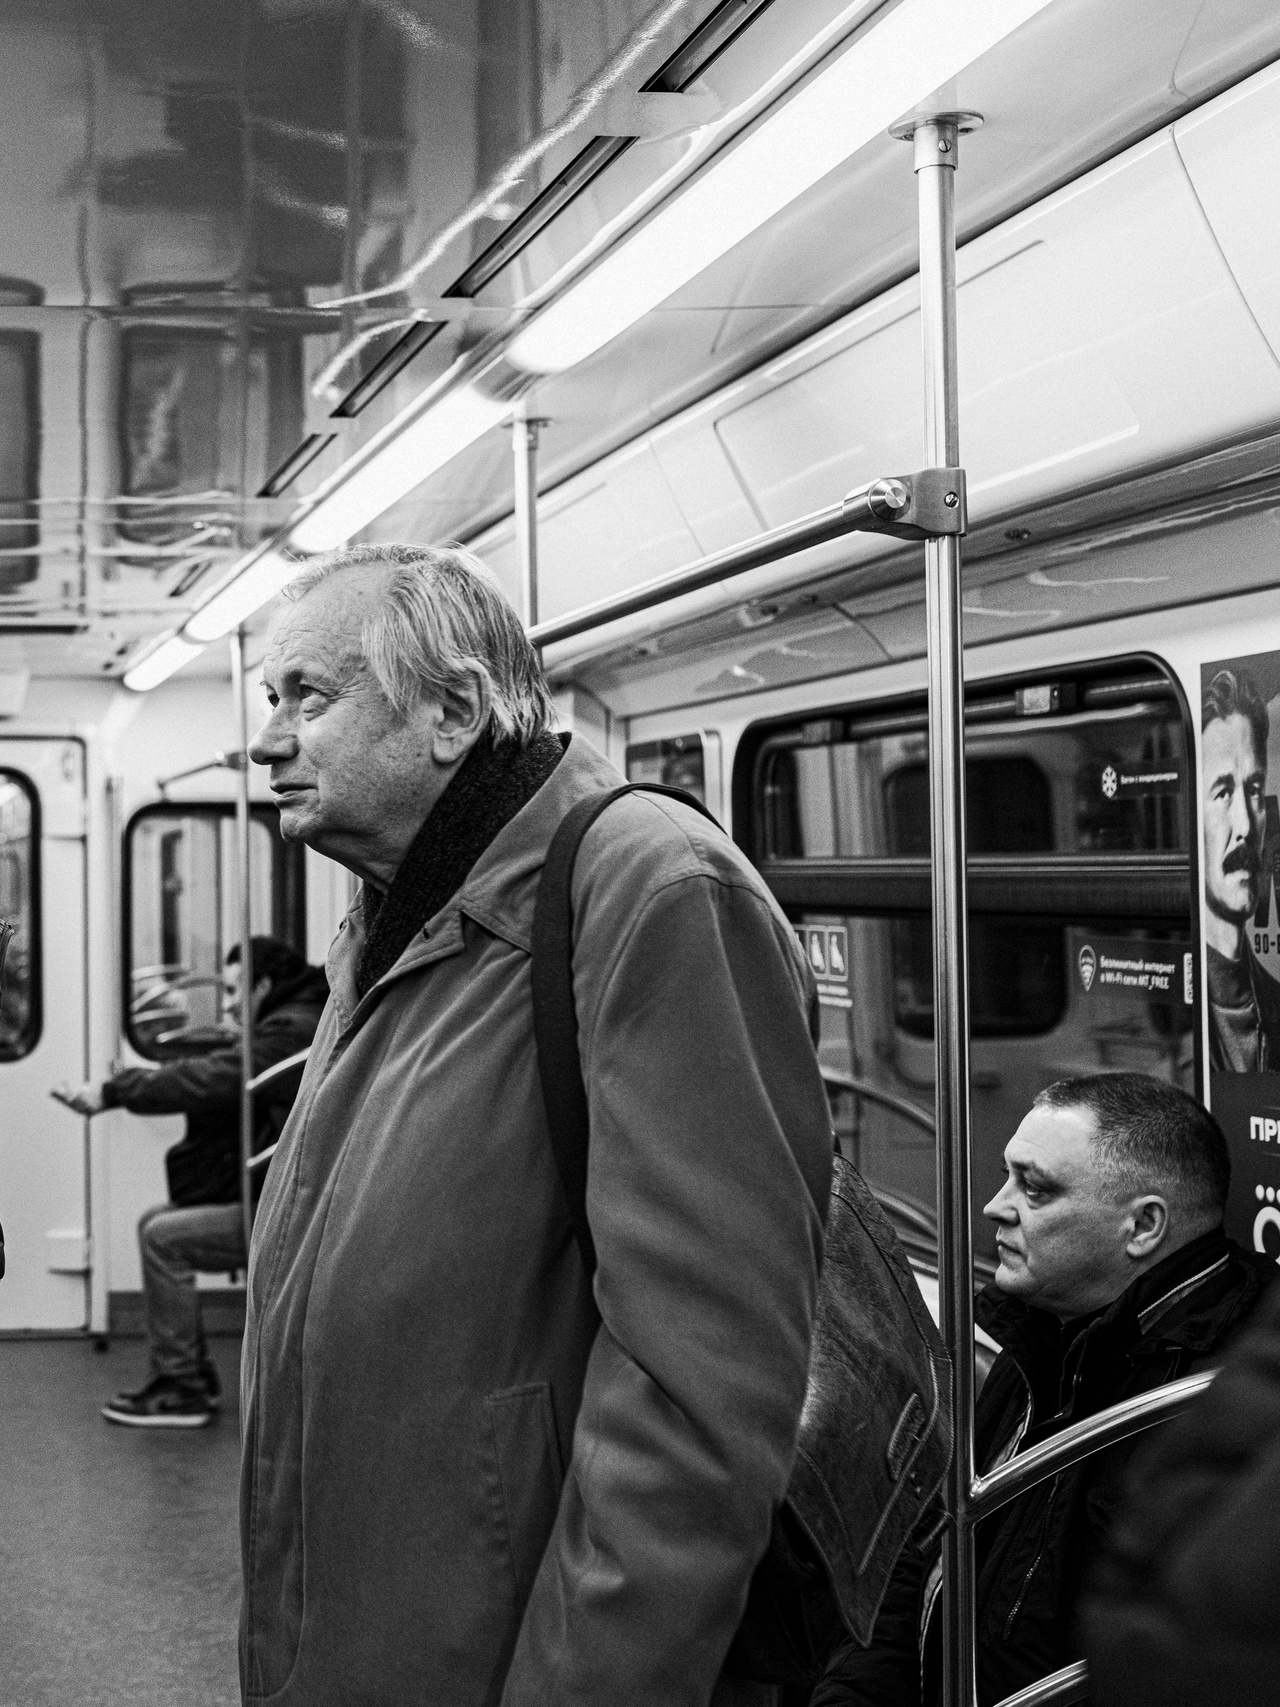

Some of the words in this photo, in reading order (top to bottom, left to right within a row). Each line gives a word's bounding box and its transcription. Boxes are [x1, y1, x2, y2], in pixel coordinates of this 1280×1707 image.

[1100, 955, 1144, 971] Безлимитный
[1144, 962, 1176, 975] интернет
[1105, 971, 1123, 985] Wi-Fi
[1122, 974, 1138, 986] сети
[1138, 974, 1170, 991] MT_FREE
[1249, 1115, 1280, 1145] ПР
